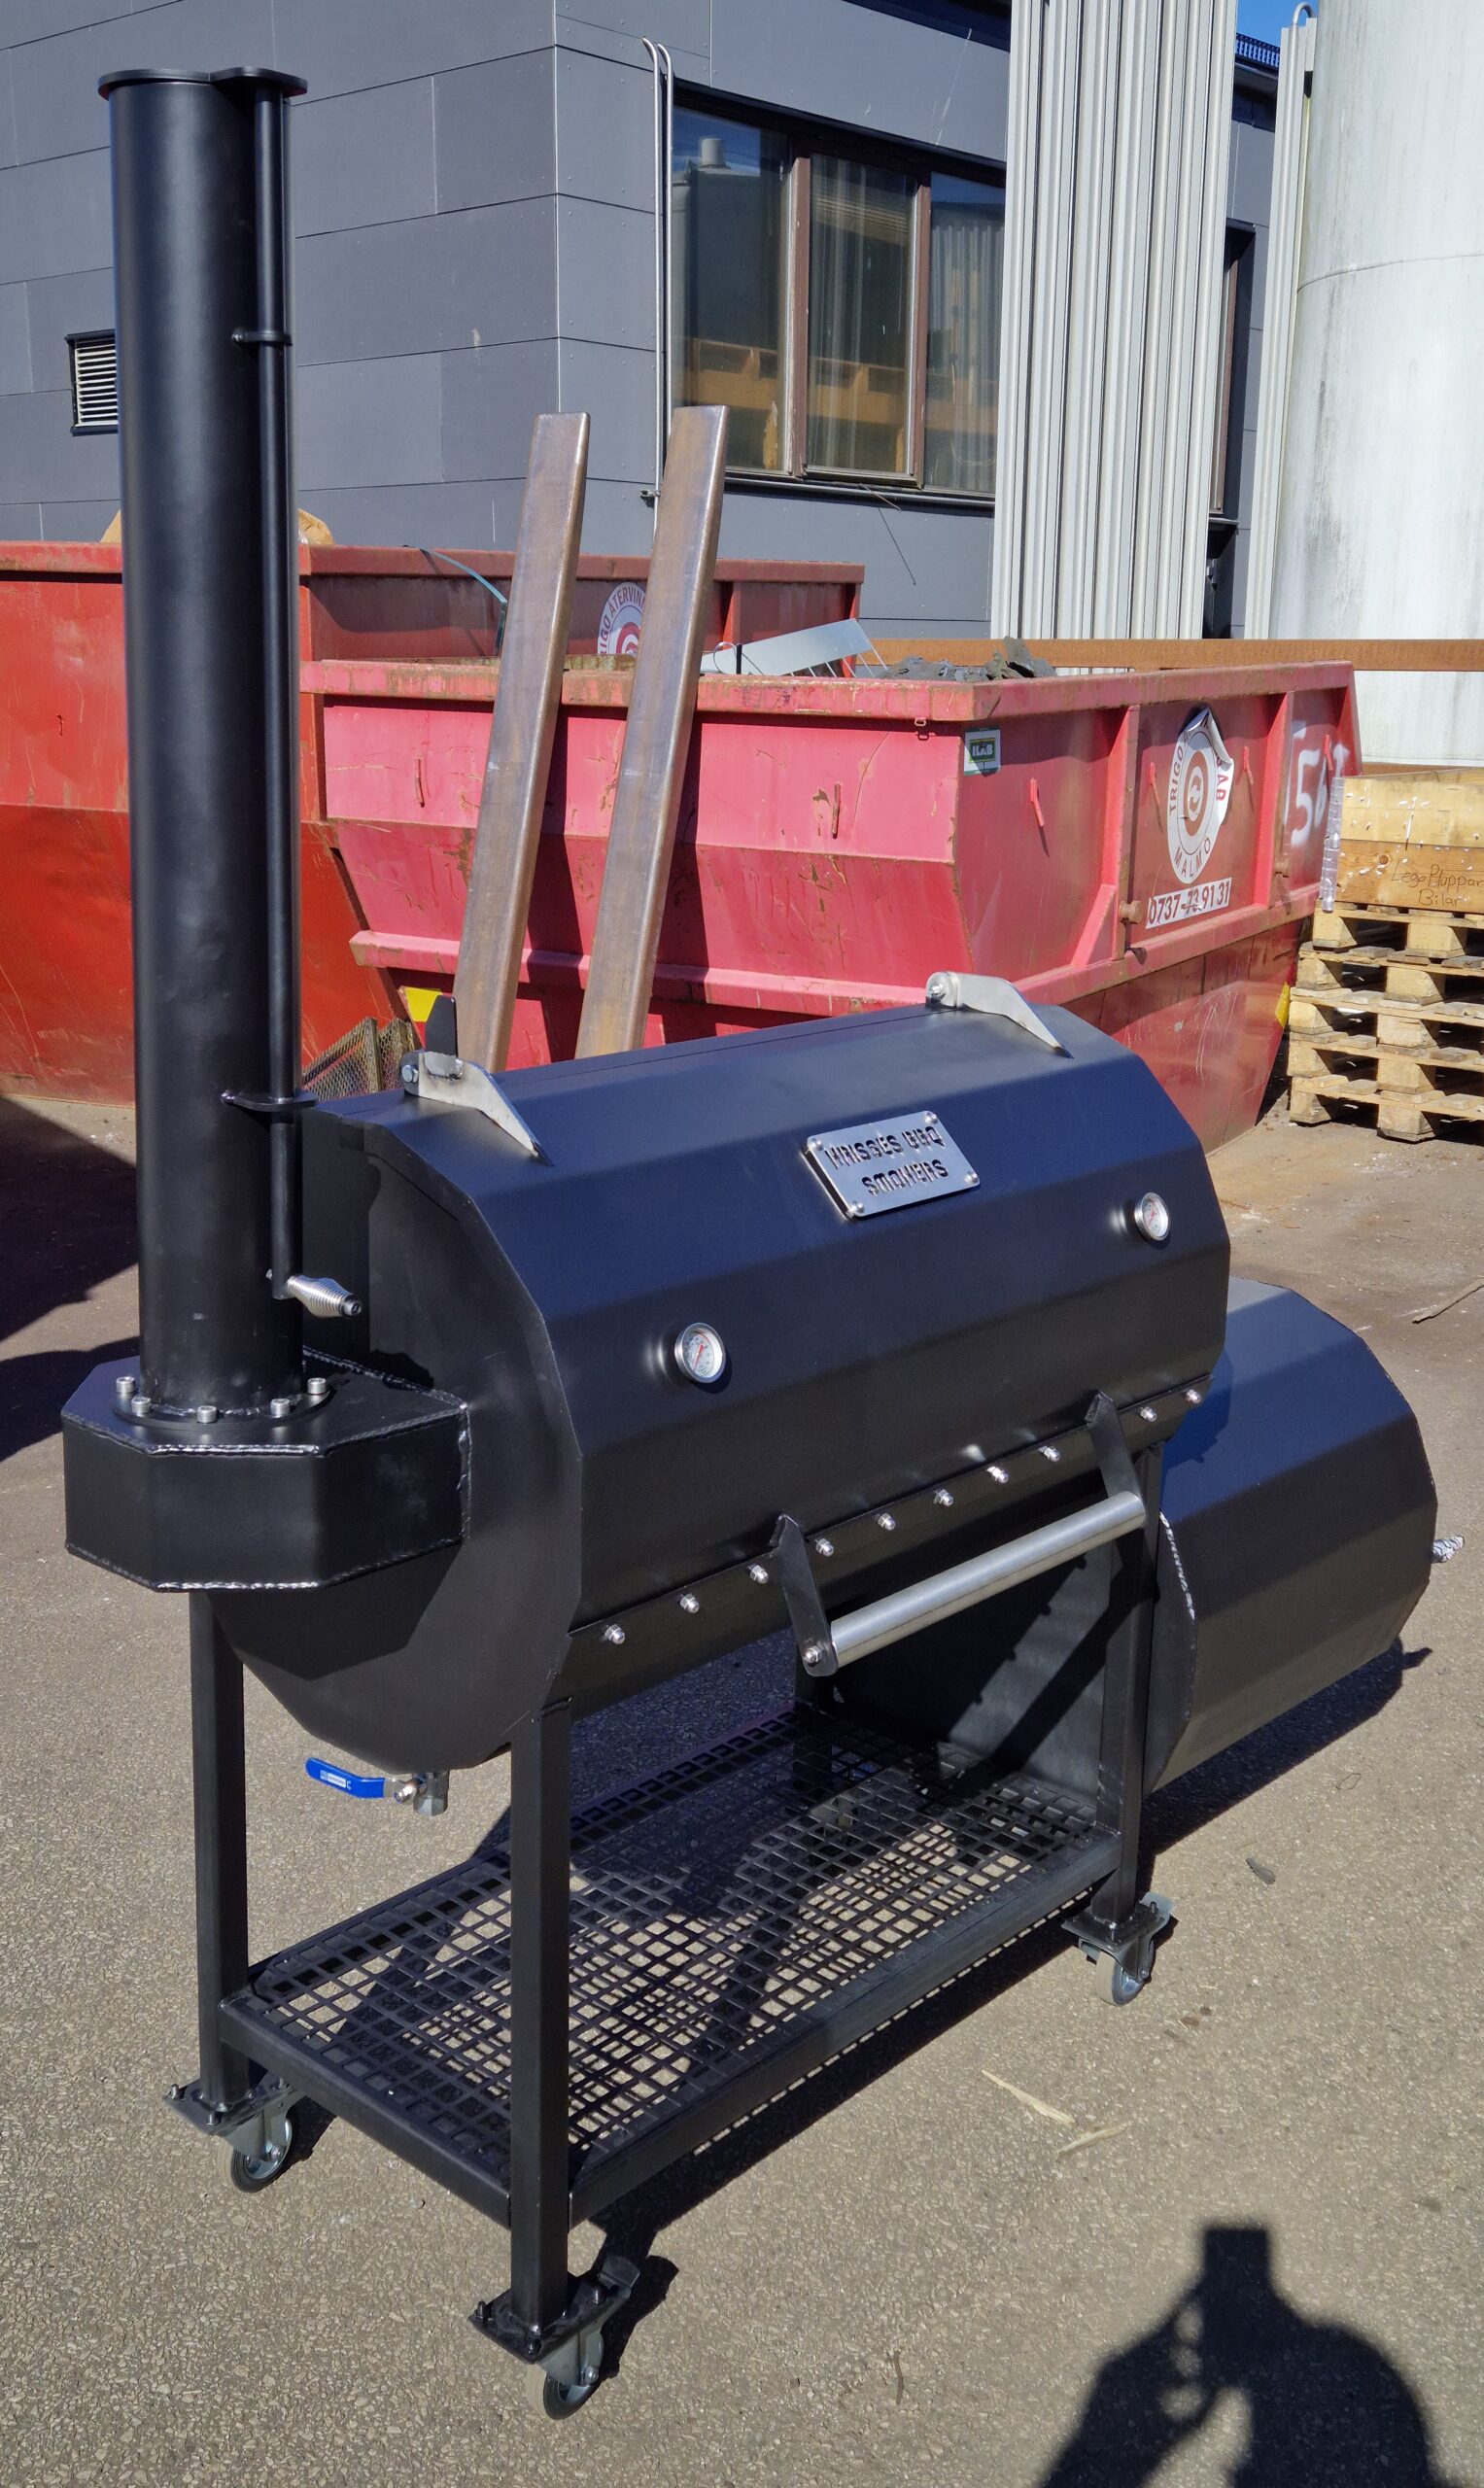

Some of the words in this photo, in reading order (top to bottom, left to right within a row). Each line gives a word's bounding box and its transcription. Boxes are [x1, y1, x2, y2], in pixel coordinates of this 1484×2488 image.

[600, 615, 611, 656] RIGO
[1169, 743, 1184, 816] TRIGO
[1216, 777, 1228, 802] AB
[1173, 835, 1212, 878] MALMÖ
[1391, 861, 1426, 887] Lego
[1419, 888, 1461, 907] Bilar
[824, 1135, 903, 1170] KRISSES
[902, 1126, 946, 1149] BBQ
[861, 1159, 949, 1195] SMOKERS
